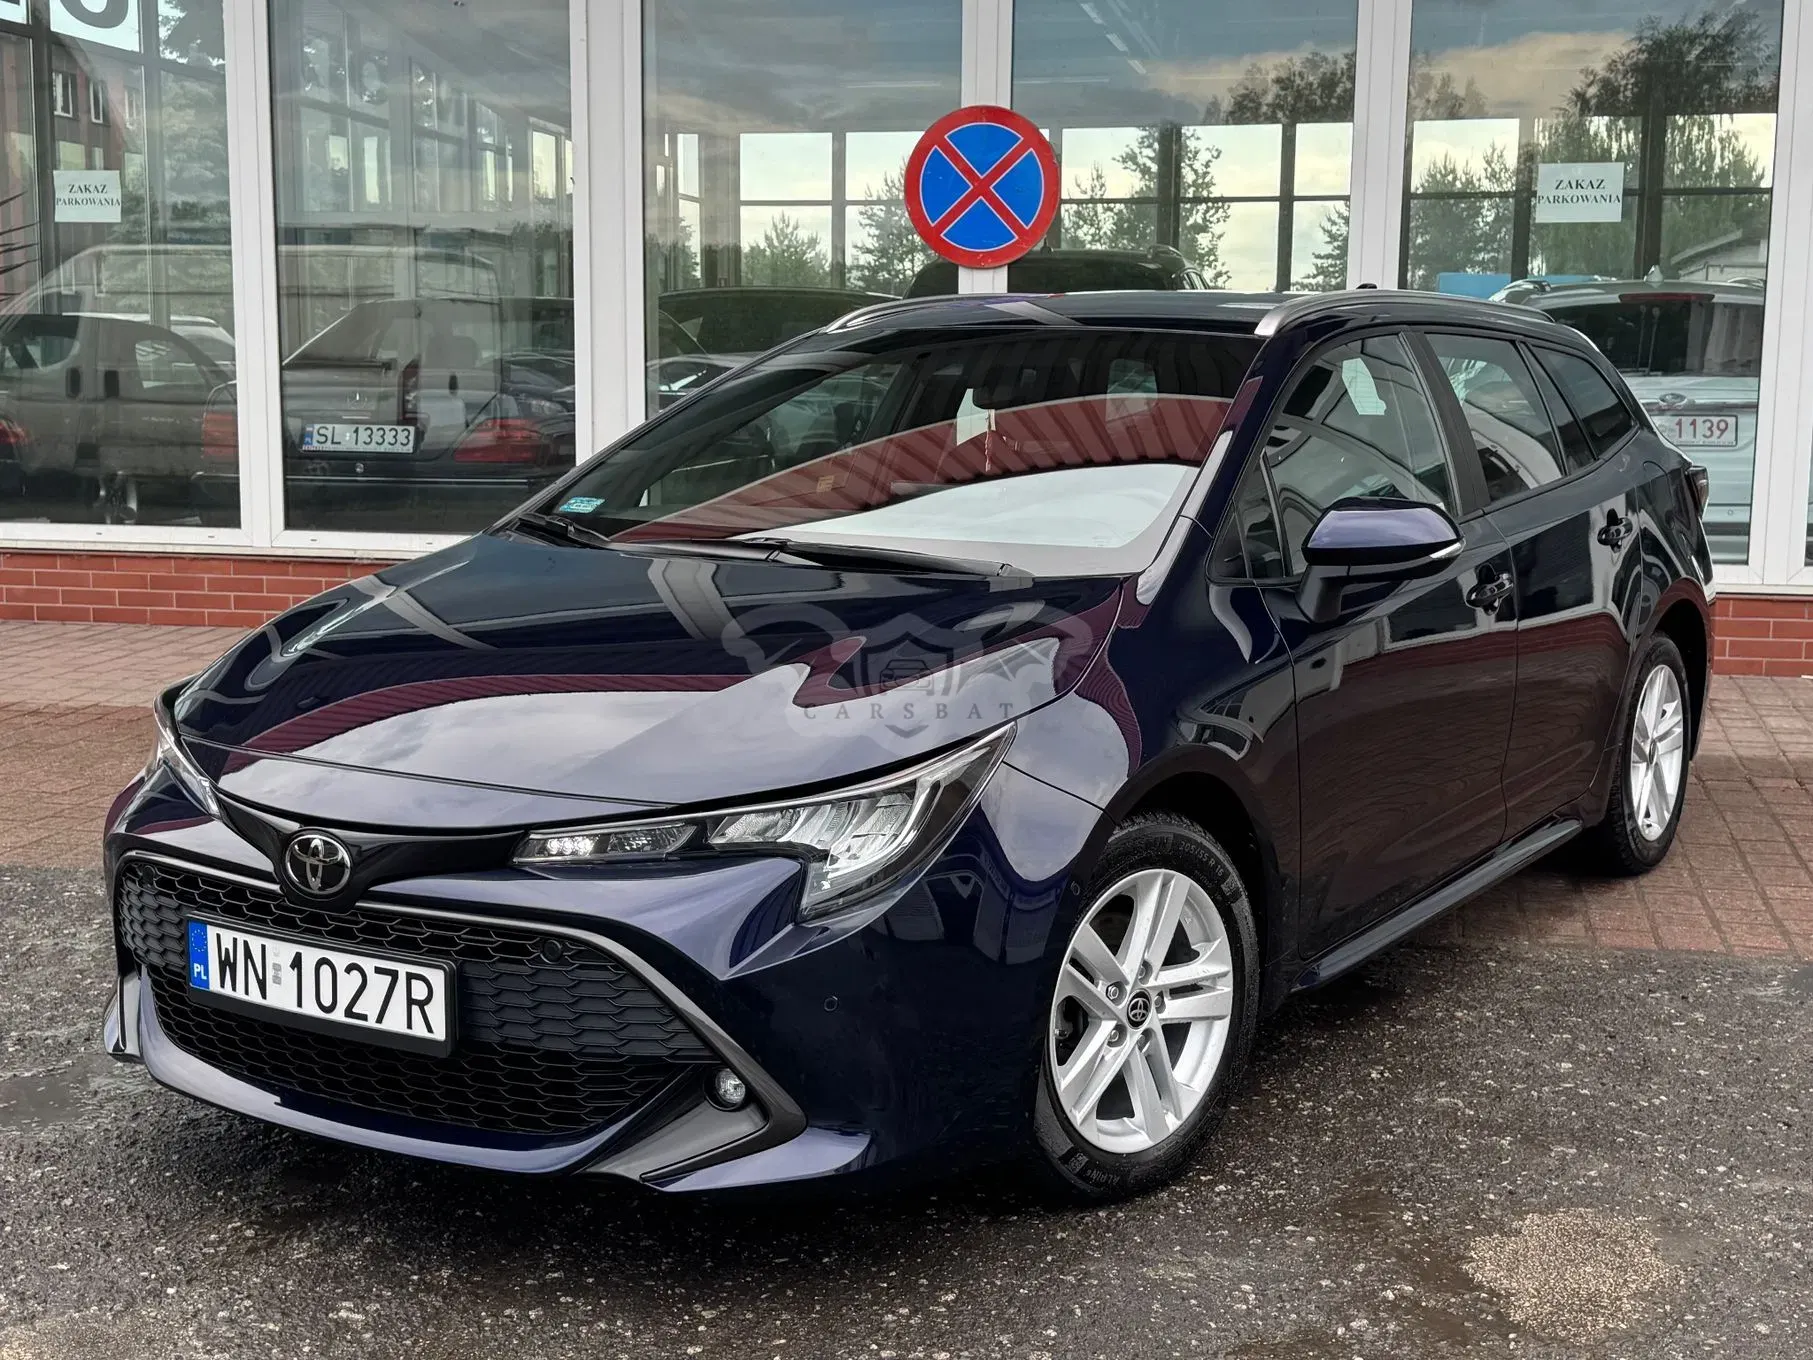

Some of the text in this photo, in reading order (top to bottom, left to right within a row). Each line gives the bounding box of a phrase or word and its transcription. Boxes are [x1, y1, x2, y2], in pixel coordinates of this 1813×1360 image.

[68, 184, 108, 194] ZAKAZ
[1555, 179, 1606, 190] ZAKAZ
[56, 197, 121, 207] PARKOWANIA
[1537, 194, 1621, 205] PARKOWANIA
[1675, 418, 1729, 439] 1139
[316, 426, 341, 445] SL
[353, 426, 411, 446] 13333
[193, 963, 208, 981] PL
[216, 932, 435, 1034] WN 1027R
